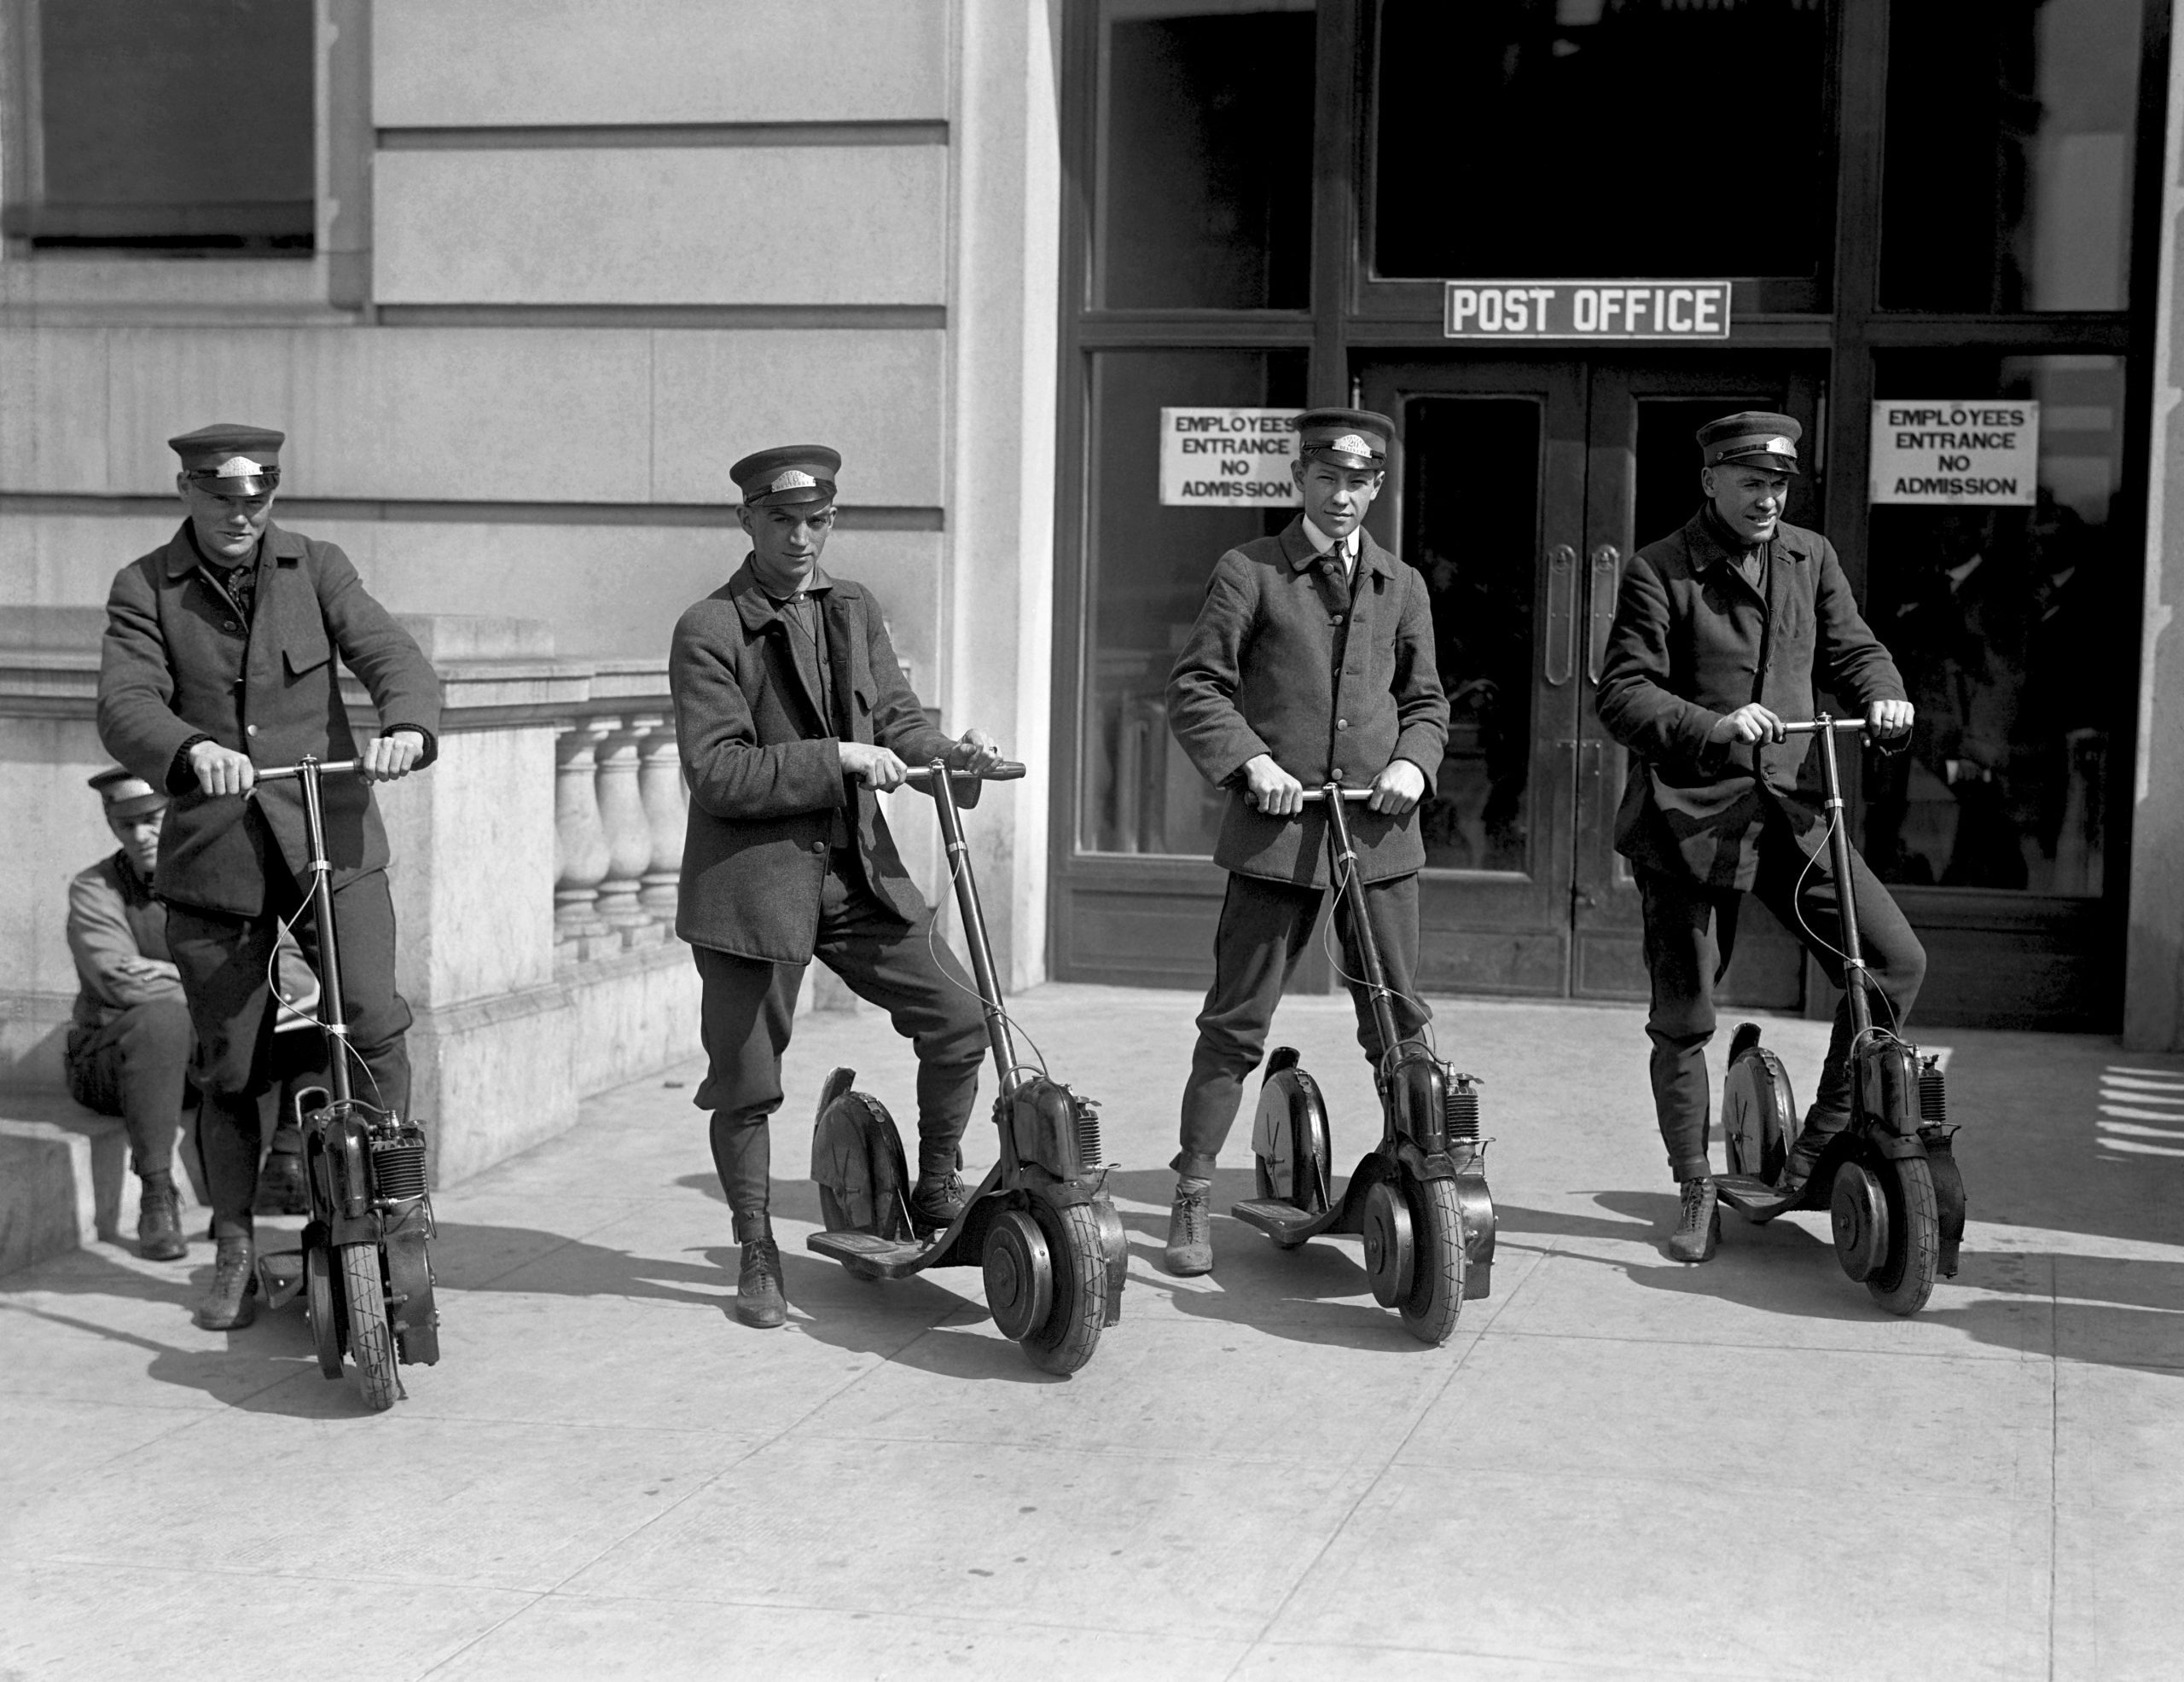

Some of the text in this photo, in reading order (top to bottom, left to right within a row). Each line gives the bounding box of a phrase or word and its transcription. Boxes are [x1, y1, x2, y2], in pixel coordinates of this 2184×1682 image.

[1453, 288, 1722, 332] POST OFFICE
[1176, 416, 1297, 432] EMPLOYEES
[1889, 409, 2024, 426] EMPLOYEES
[1182, 438, 1290, 455] ENTRANCE
[1896, 432, 2017, 449] ENTRANCE
[1221, 459, 1250, 475] NO
[1938, 455, 1971, 472] NO
[1182, 480, 1292, 497] ADMISSION
[1894, 477, 2017, 495] ADMISSION
